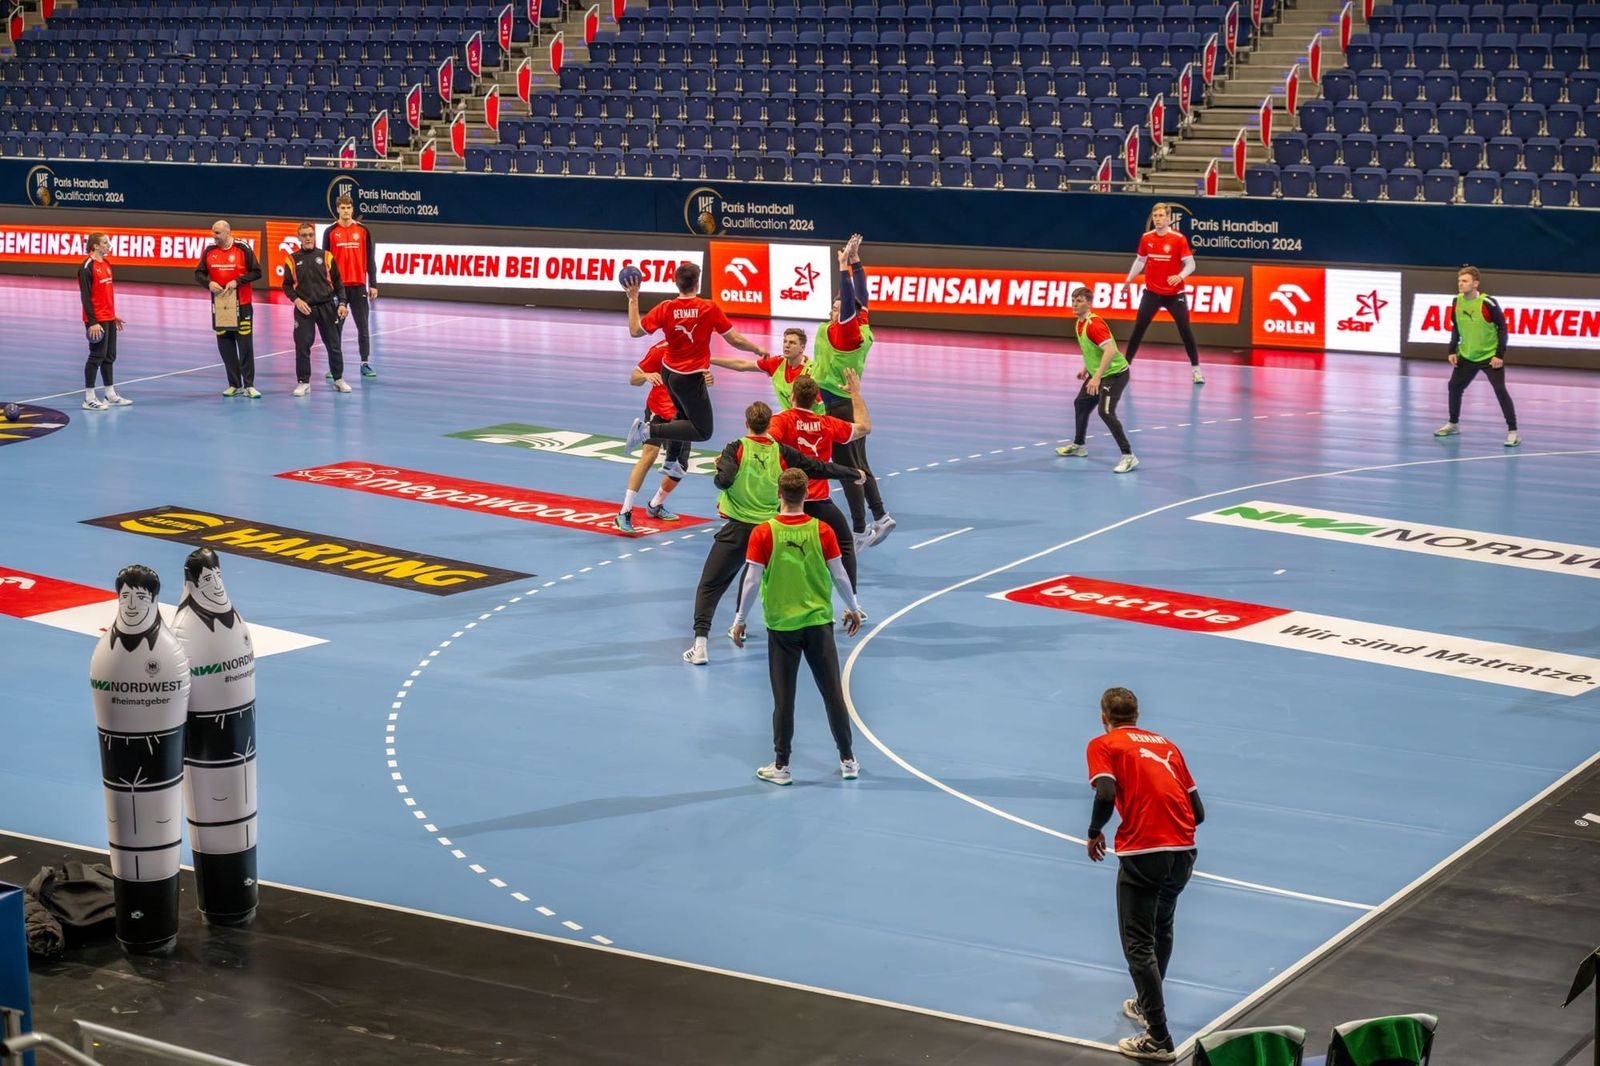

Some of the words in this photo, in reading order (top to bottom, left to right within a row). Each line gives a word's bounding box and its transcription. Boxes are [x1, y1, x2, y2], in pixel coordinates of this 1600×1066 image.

[53, 177, 72, 188] Paris
[73, 178, 109, 189] Handball
[54, 190, 105, 202] Qualification
[105, 192, 125, 203] 2024
[358, 189, 379, 200] Paris
[380, 189, 421, 201] Handball
[359, 202, 416, 215] Qualification
[417, 205, 439, 216] 2024
[721, 202, 745, 213] Paris
[747, 203, 794, 216] Handball
[721, 217, 788, 230] Qualification
[789, 219, 815, 231] 2024
[1190, 218, 1219, 231] Paris
[1222, 220, 1278, 234] Handball
[1191, 234, 1270, 249] Qualification
[1272, 238, 1302, 251] 2024
[381, 252, 500, 277] AUFTANKEN
[505, 256, 539, 278] BEI
[546, 257, 615, 281] ORLEN
[640, 259, 692, 283] STA
[720, 289, 763, 303] ORLEN
[779, 287, 810, 301] star
[866, 275, 1002, 305] EMEINSAM
[1093, 282, 1233, 313] BEWEN
[673, 309, 699, 319] GERMANY
[1421, 305, 1600, 337] AANKEN
[1263, 319, 1316, 335] ORLEN
[1336, 316, 1374, 333] star
[361, 475, 661, 535] megawood.cm
[202, 528, 489, 587] HARTING
[1040, 585, 1241, 624] bett1.de
[1279, 624, 1341, 641] Wir
[1341, 636, 1428, 655] sind
[1423, 649, 1598, 685] Matratze.
[111, 680, 183, 693] NORDWEST
[111, 697, 171, 708] #heimatgeber
